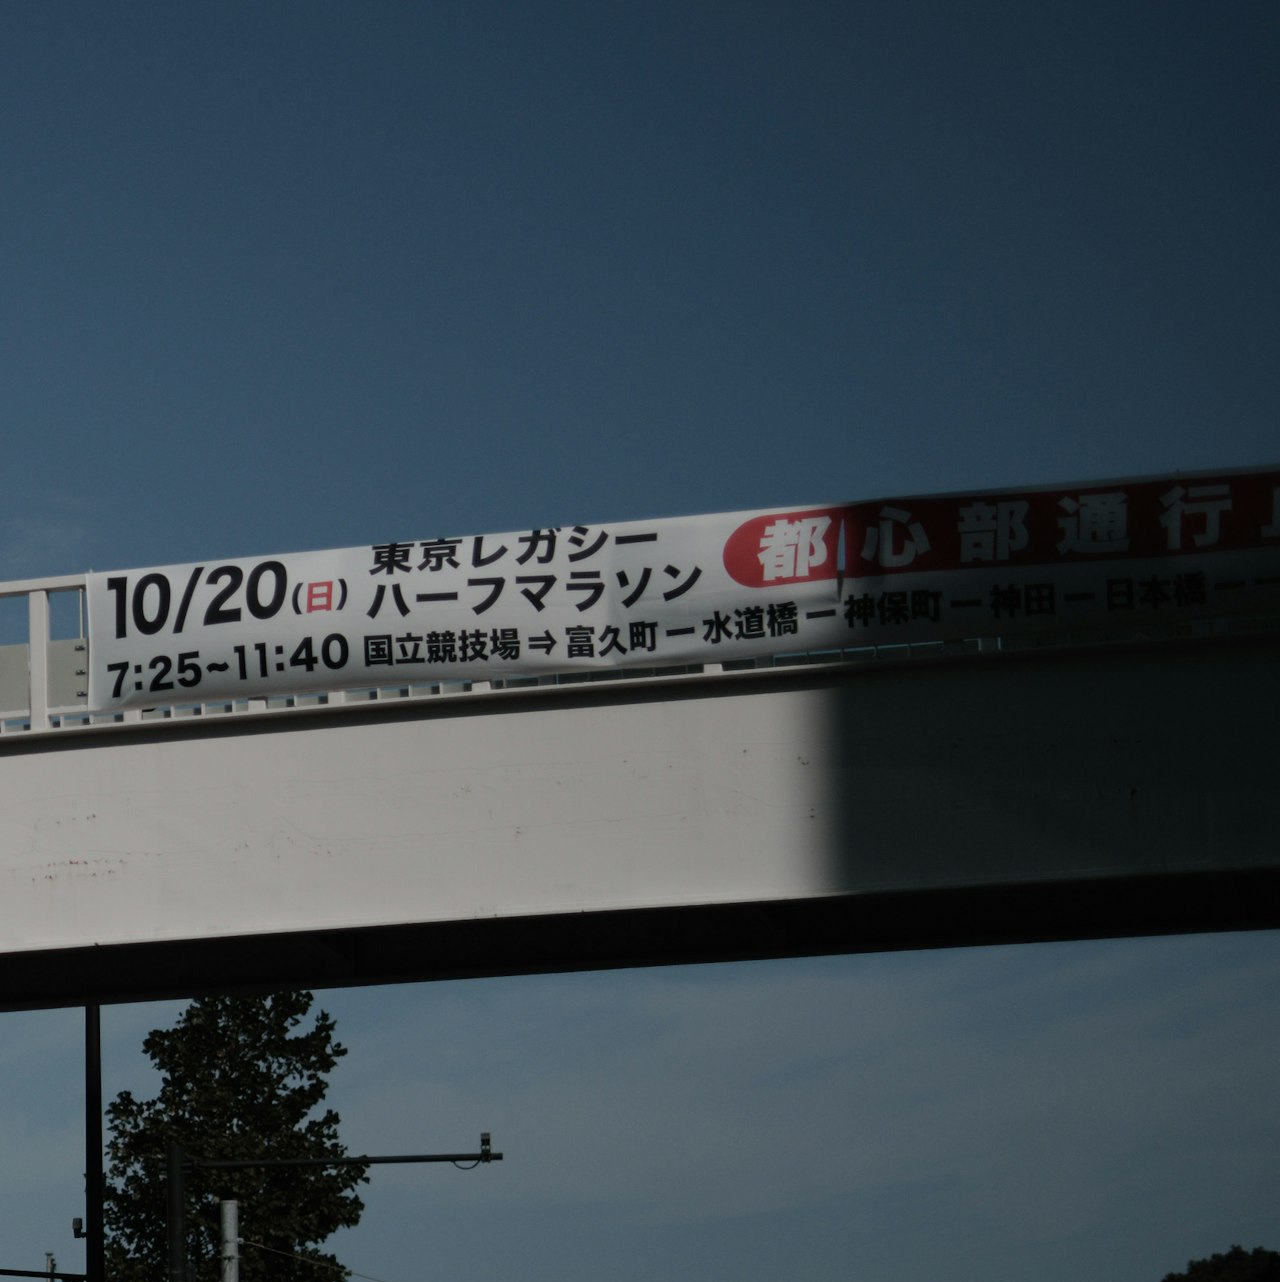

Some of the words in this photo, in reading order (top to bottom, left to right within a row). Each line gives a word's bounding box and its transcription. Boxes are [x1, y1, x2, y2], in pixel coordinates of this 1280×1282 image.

[371, 525, 659, 576] 東京レガシー
[366, 564, 702, 620] ハーフマラソン
